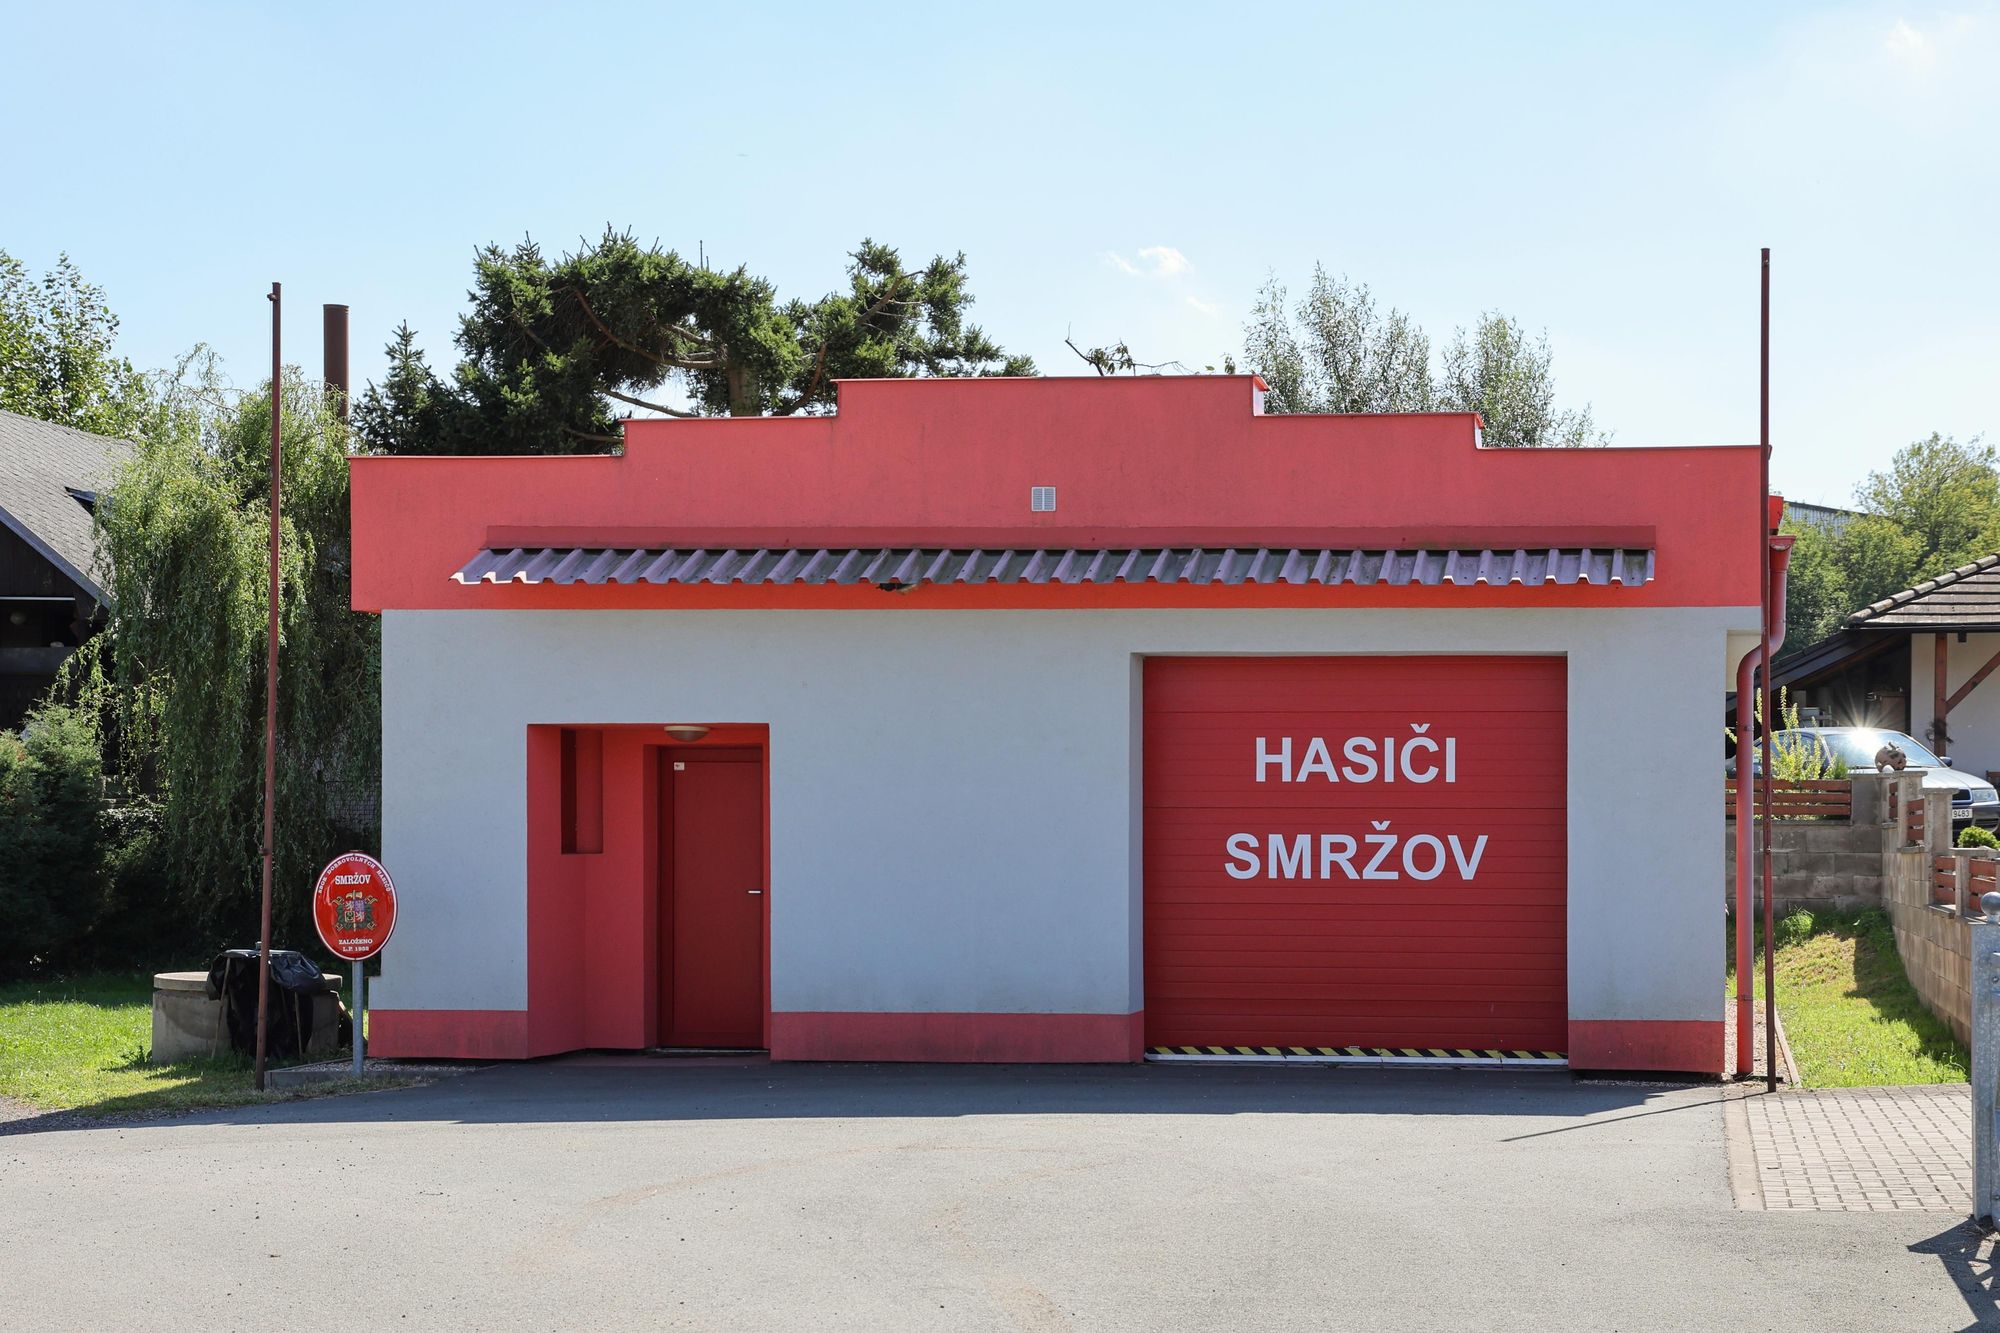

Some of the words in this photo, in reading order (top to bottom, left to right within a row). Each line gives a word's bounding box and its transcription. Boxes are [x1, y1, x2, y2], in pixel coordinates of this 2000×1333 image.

[1256, 724, 1456, 784] HASIČI
[1953, 809, 1970, 818] 9483
[1225, 821, 1489, 881] SMRŽOV
[335, 872, 371, 885] SMRŽOV
